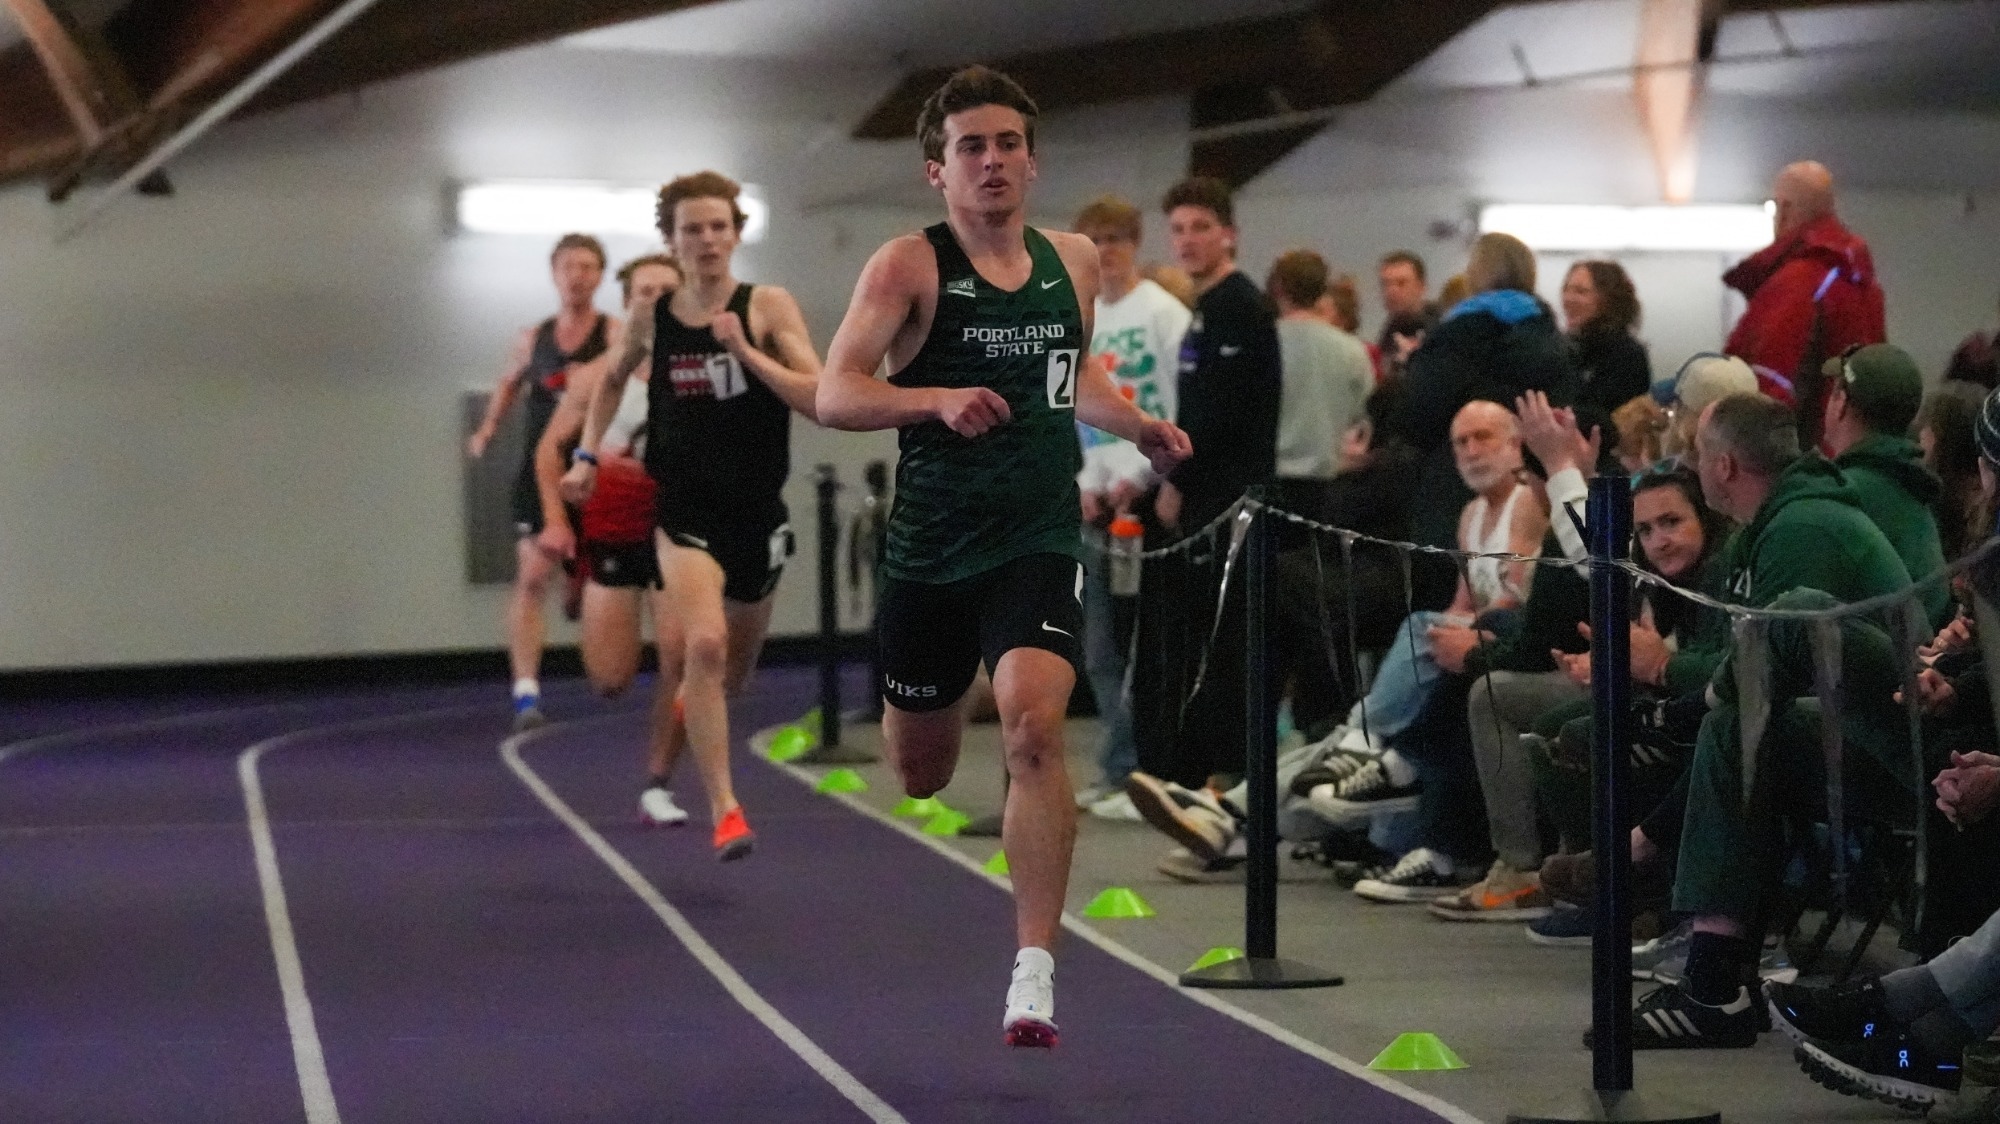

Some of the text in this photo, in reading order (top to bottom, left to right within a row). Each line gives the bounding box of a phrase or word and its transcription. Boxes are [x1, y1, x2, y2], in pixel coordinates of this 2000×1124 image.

[962, 324, 1065, 342] PORTLAND
[985, 341, 1045, 358] STATE
[713, 358, 732, 393] 7
[1054, 352, 1071, 404] 2
